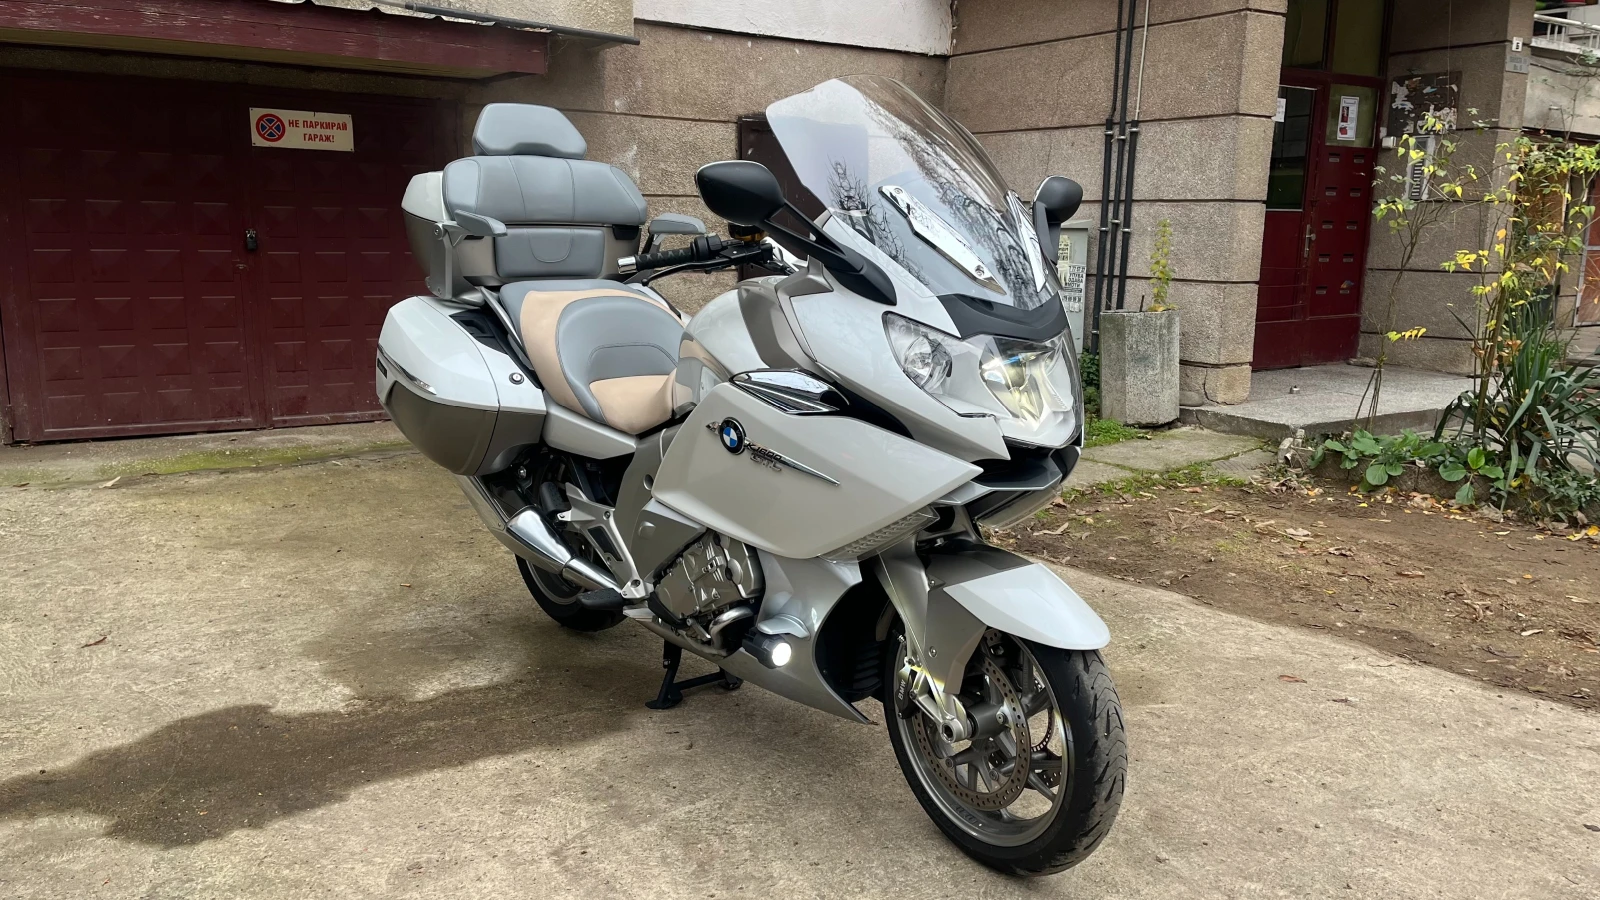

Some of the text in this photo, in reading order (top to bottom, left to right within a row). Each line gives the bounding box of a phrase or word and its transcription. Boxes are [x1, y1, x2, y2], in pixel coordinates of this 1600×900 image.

[288, 119, 348, 131] НЕ ПАРКИРАЙ
[303, 133, 335, 143] ГАРАЖ!
[898, 680, 906, 700] BMW
